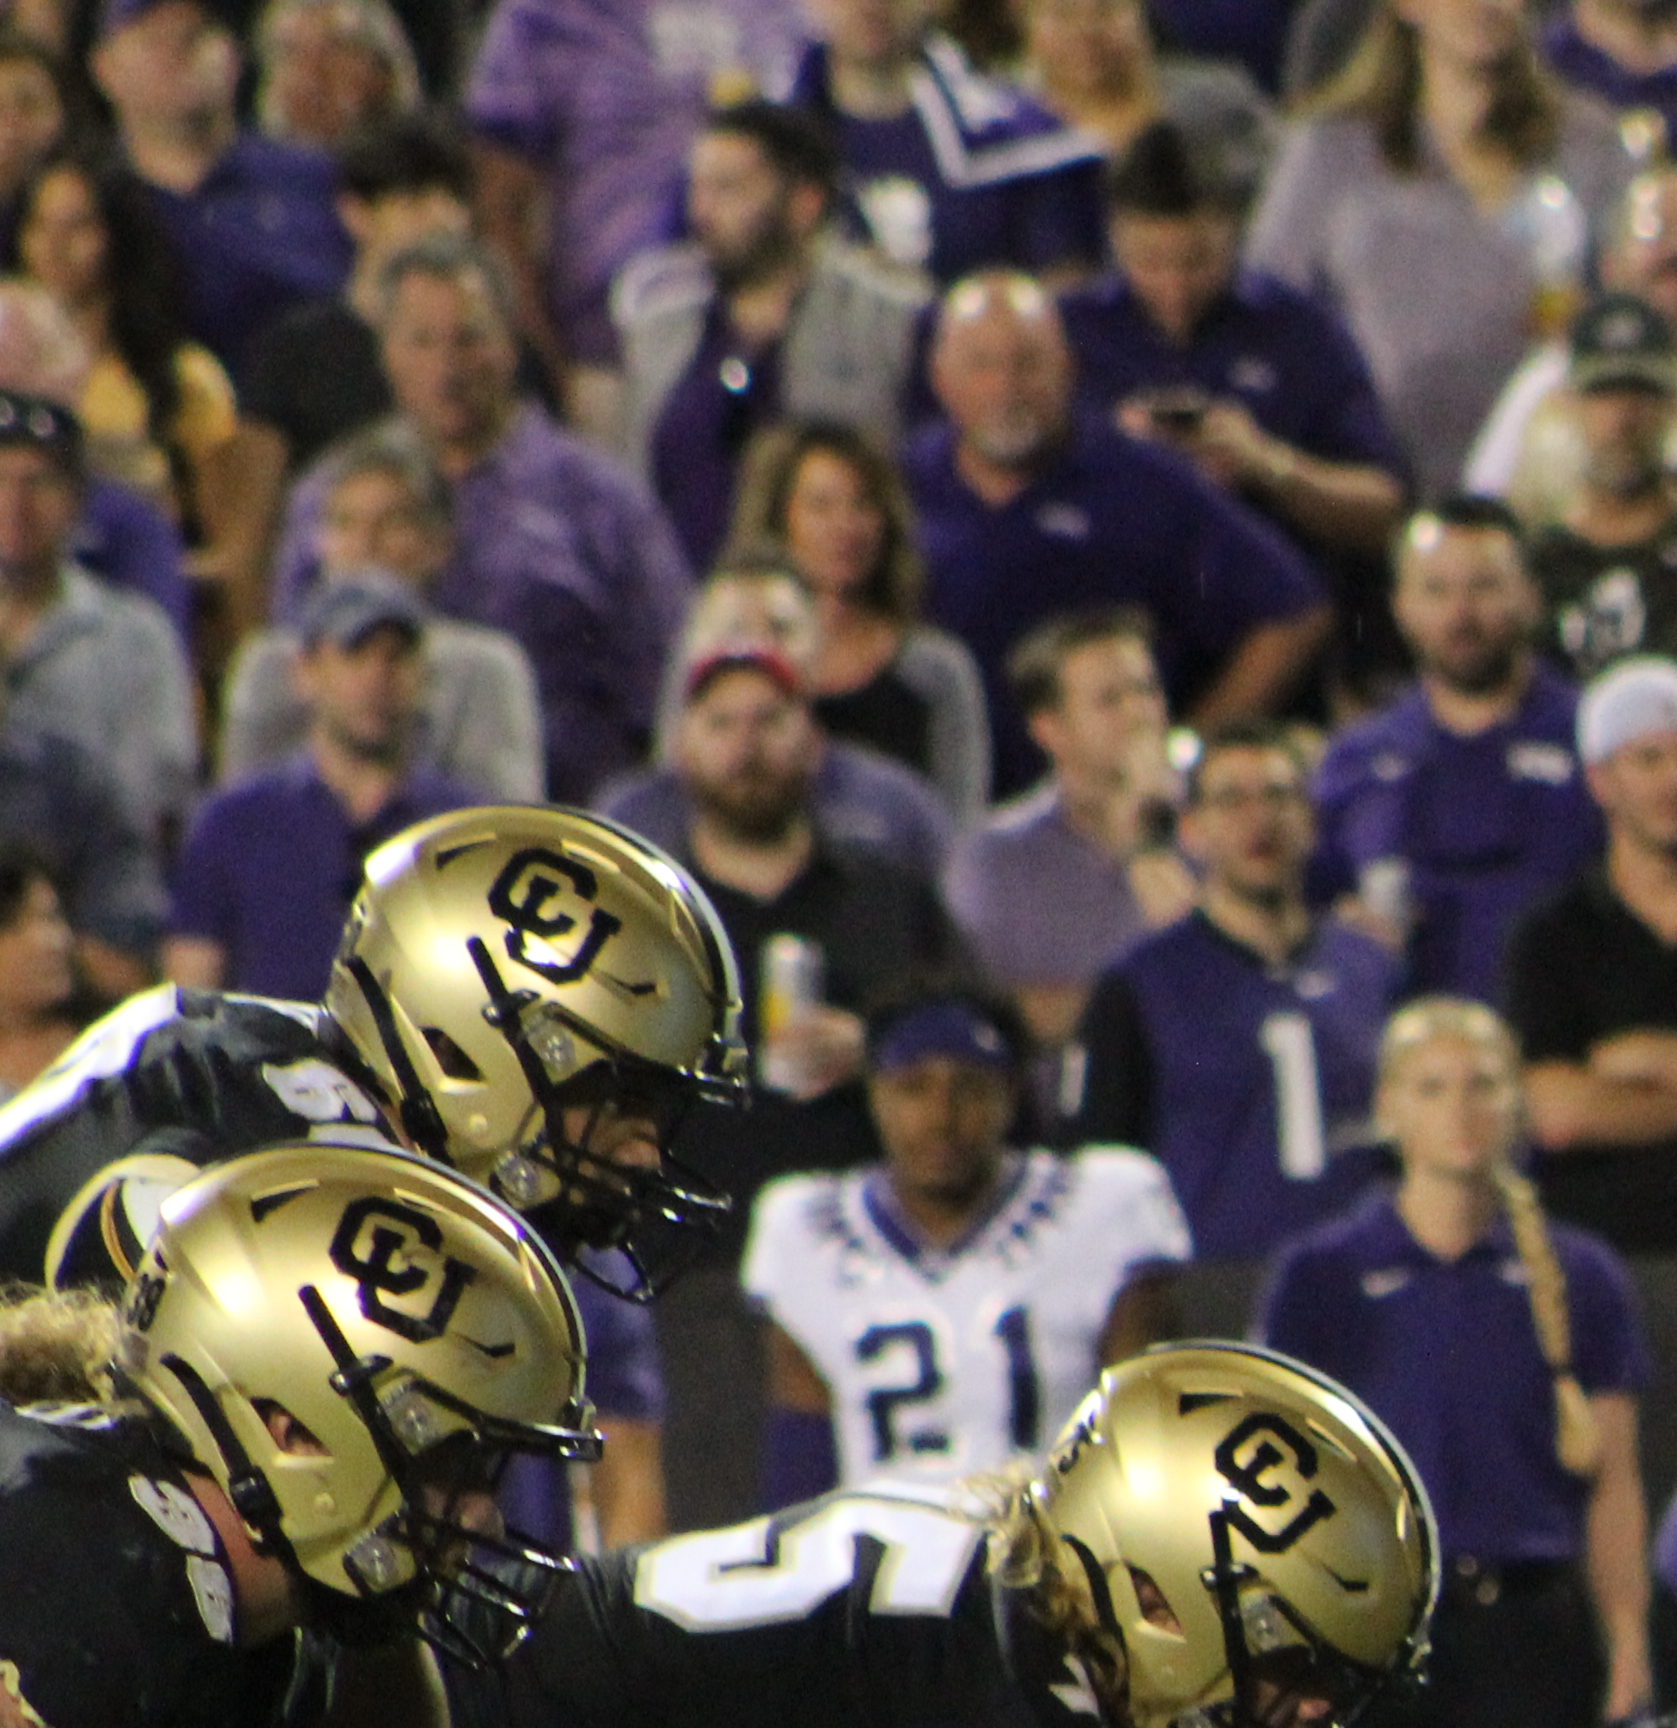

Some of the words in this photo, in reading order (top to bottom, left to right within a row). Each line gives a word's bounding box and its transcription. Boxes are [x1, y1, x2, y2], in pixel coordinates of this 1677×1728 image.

[488, 848, 622, 985] CU
[1257, 1012, 1329, 1182] 1
[328, 1195, 477, 1344] CU
[855, 1304, 1042, 1463] 21
[1214, 1410, 1337, 1554] CU
[633, 1482, 992, 1635] 5
